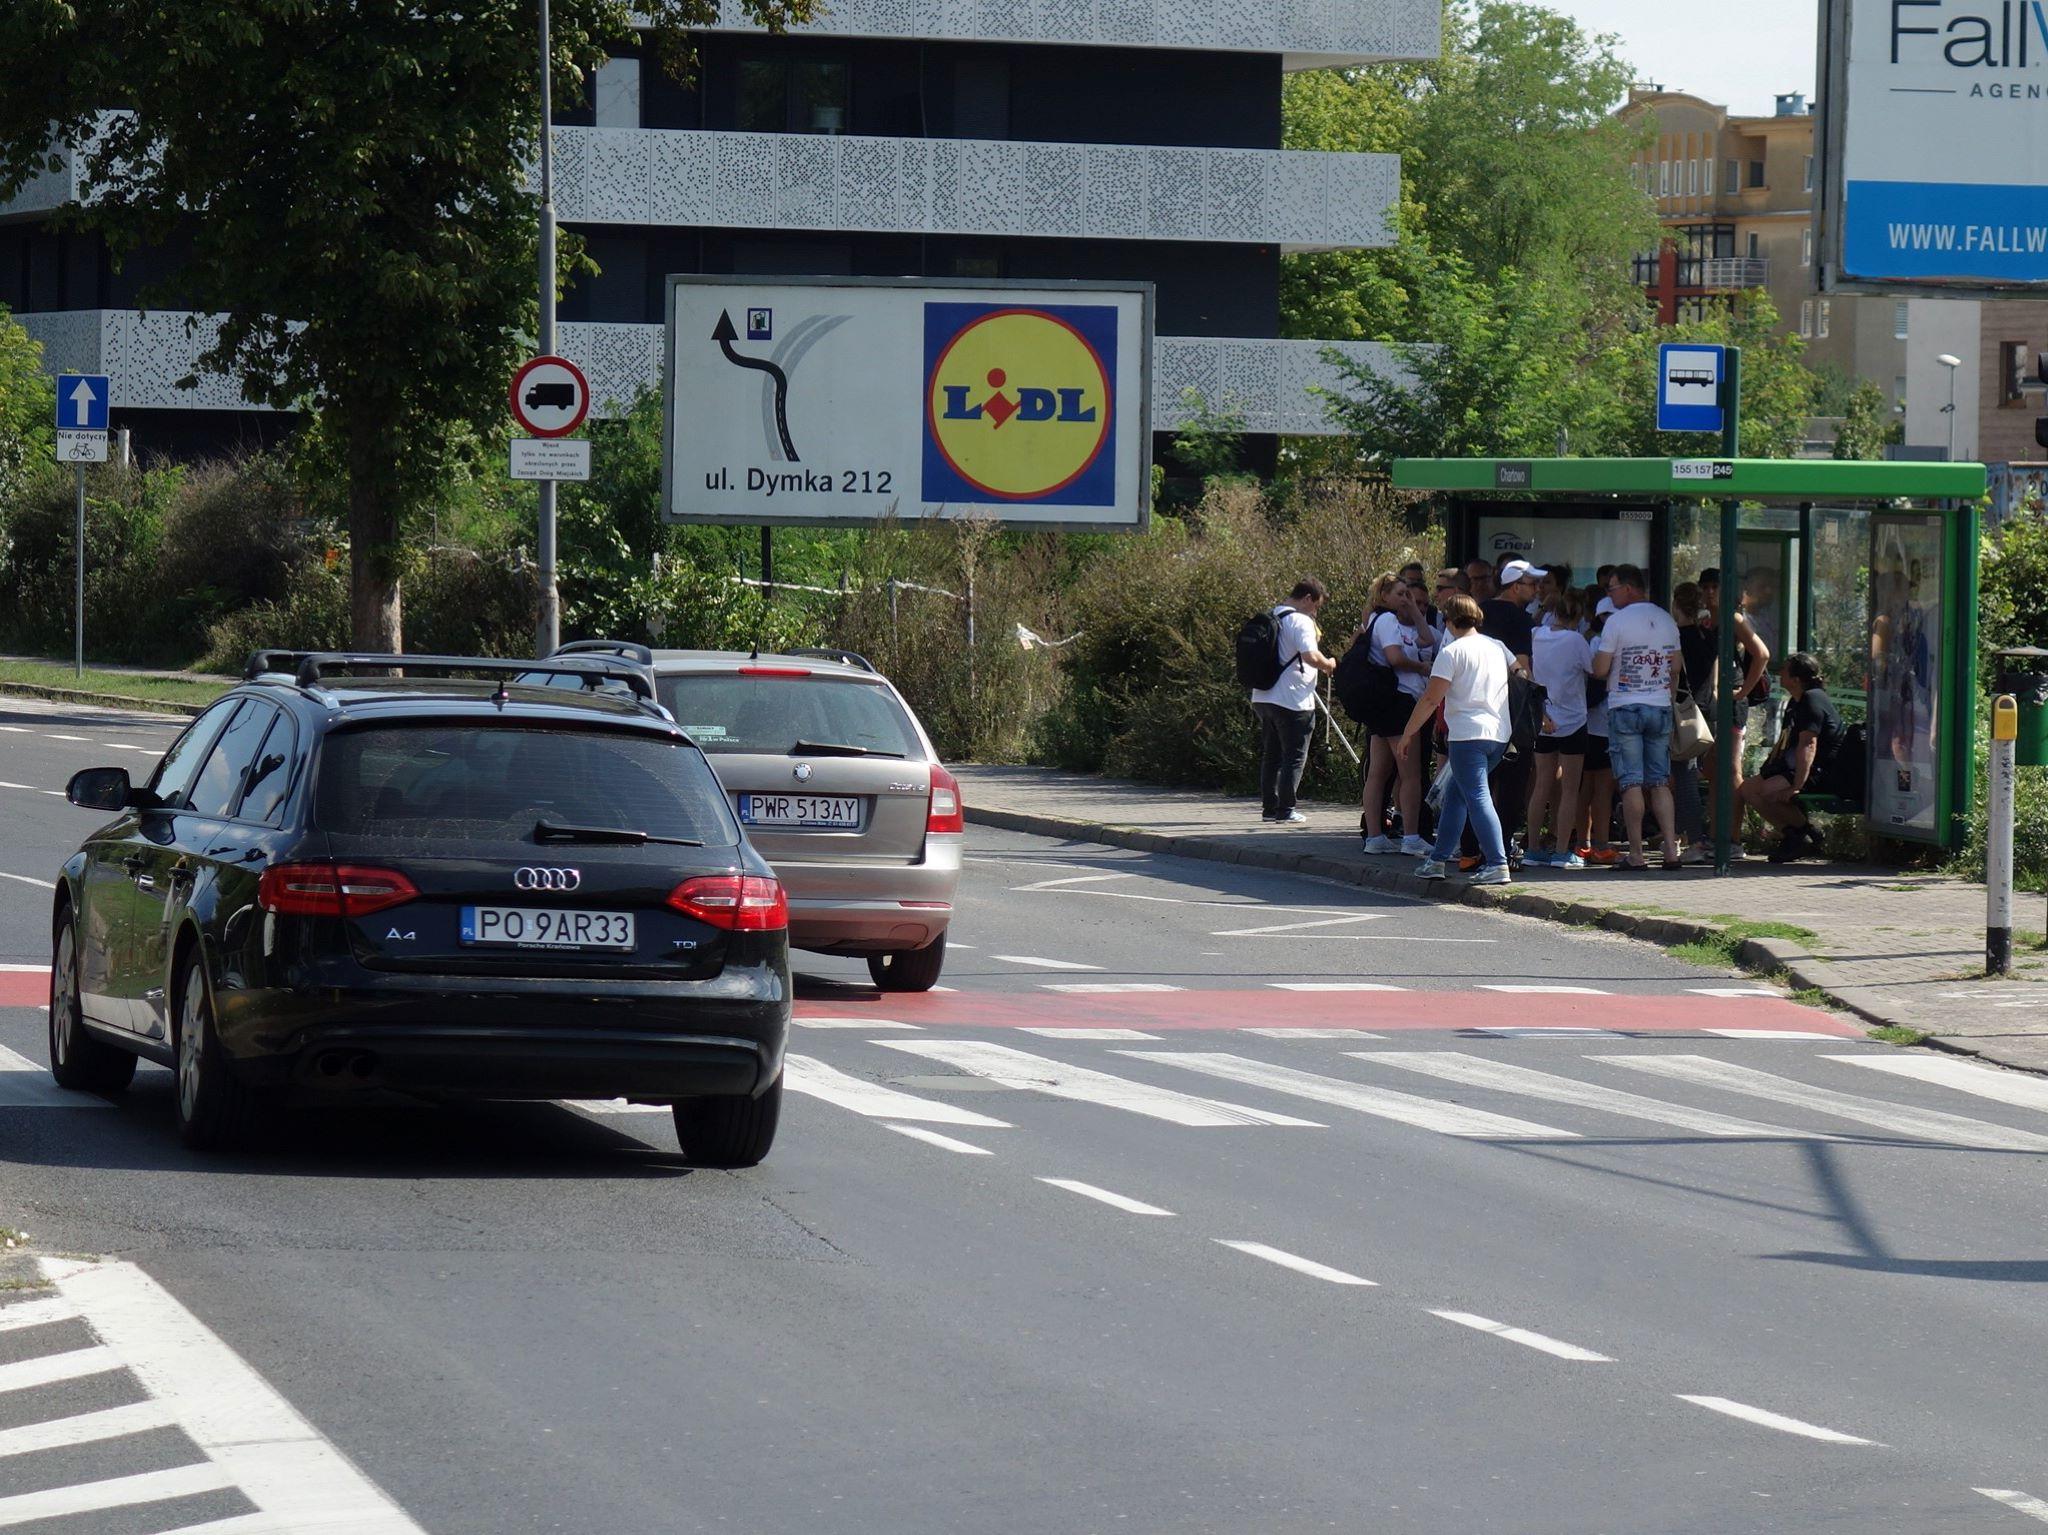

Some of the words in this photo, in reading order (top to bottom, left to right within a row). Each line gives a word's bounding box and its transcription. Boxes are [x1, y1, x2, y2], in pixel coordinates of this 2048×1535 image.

[1969, 83, 2048, 99] AGEN
[1888, 223, 2048, 253] WWW.FALLW
[76, 432, 107, 441] dotyczy
[1674, 464, 1692, 474] 155
[1695, 464, 1711, 475] 157
[1714, 465, 1733, 476] 245
[706, 467, 735, 490] ul.
[747, 467, 833, 497] Dymka
[842, 470, 892, 493] 212
[1494, 539, 1532, 550] Enea
[752, 797, 789, 818] PWR
[797, 799, 856, 820] 513AY
[462, 927, 474, 936] PL
[481, 910, 524, 939] PO
[536, 913, 629, 943] 9AR33
[672, 940, 697, 949] TDI
